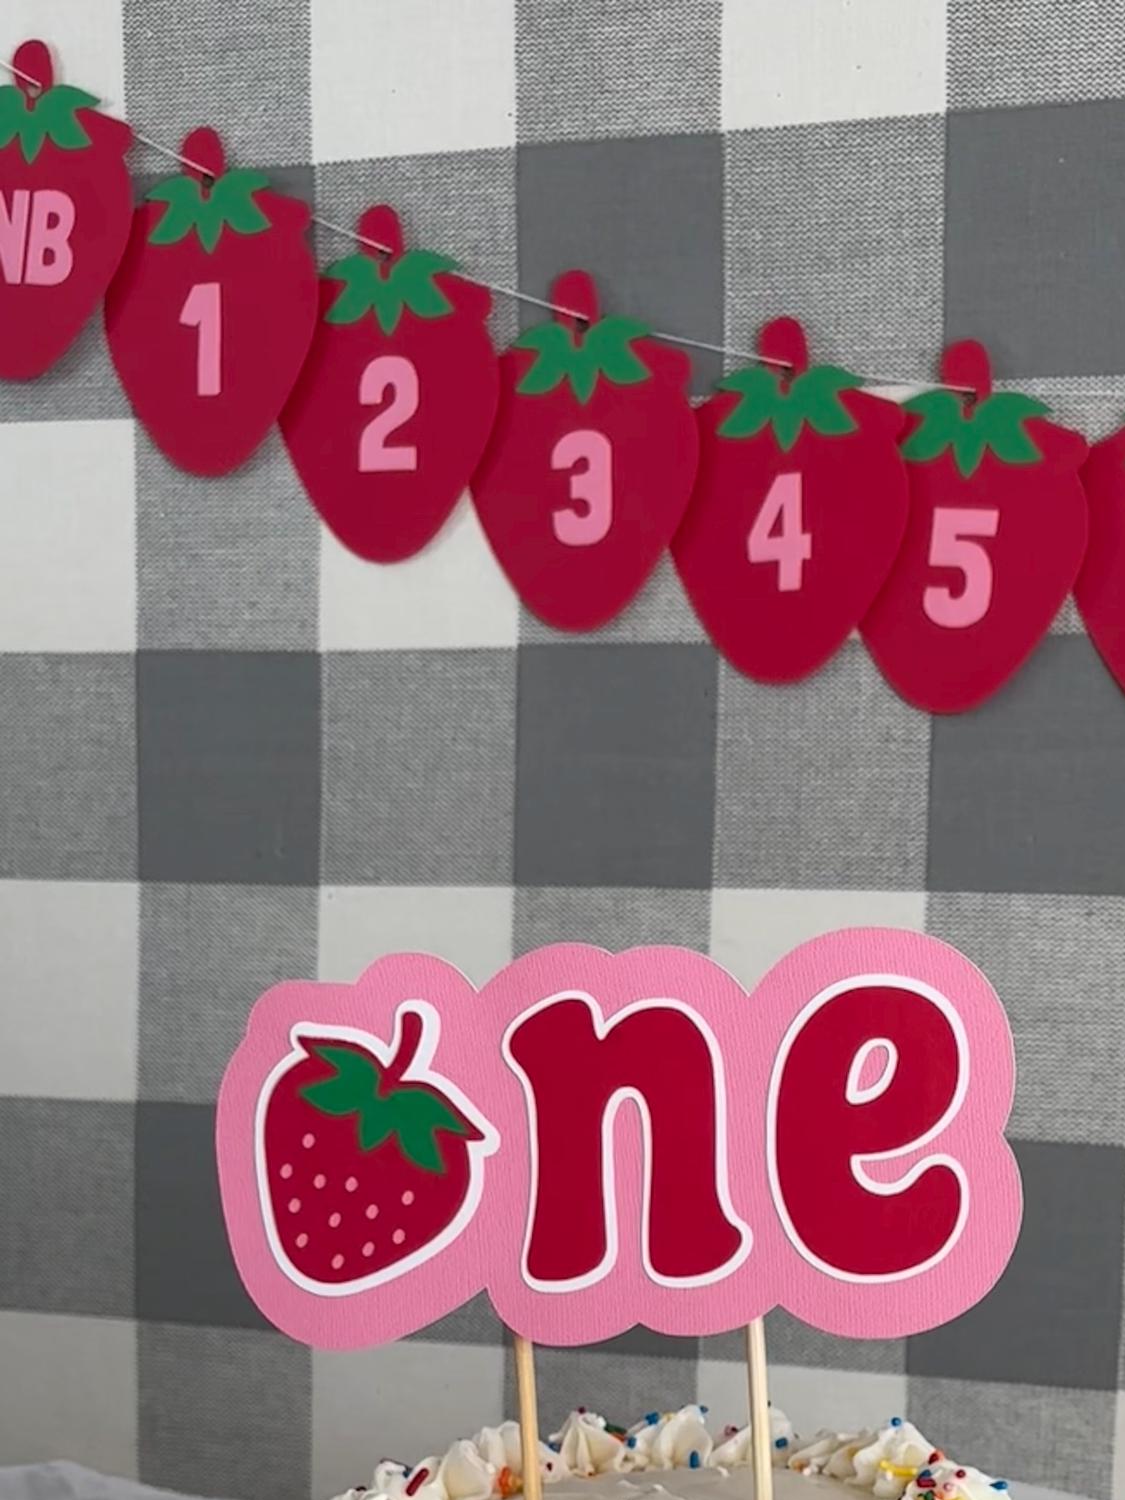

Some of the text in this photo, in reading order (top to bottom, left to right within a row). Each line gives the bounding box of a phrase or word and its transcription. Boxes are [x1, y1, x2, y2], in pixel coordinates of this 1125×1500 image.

[179, 282, 222, 397] 1
[358, 356, 420, 472] 2
[551, 430, 613, 546] 3
[747, 472, 812, 592] 4
[923, 508, 999, 629] 5
